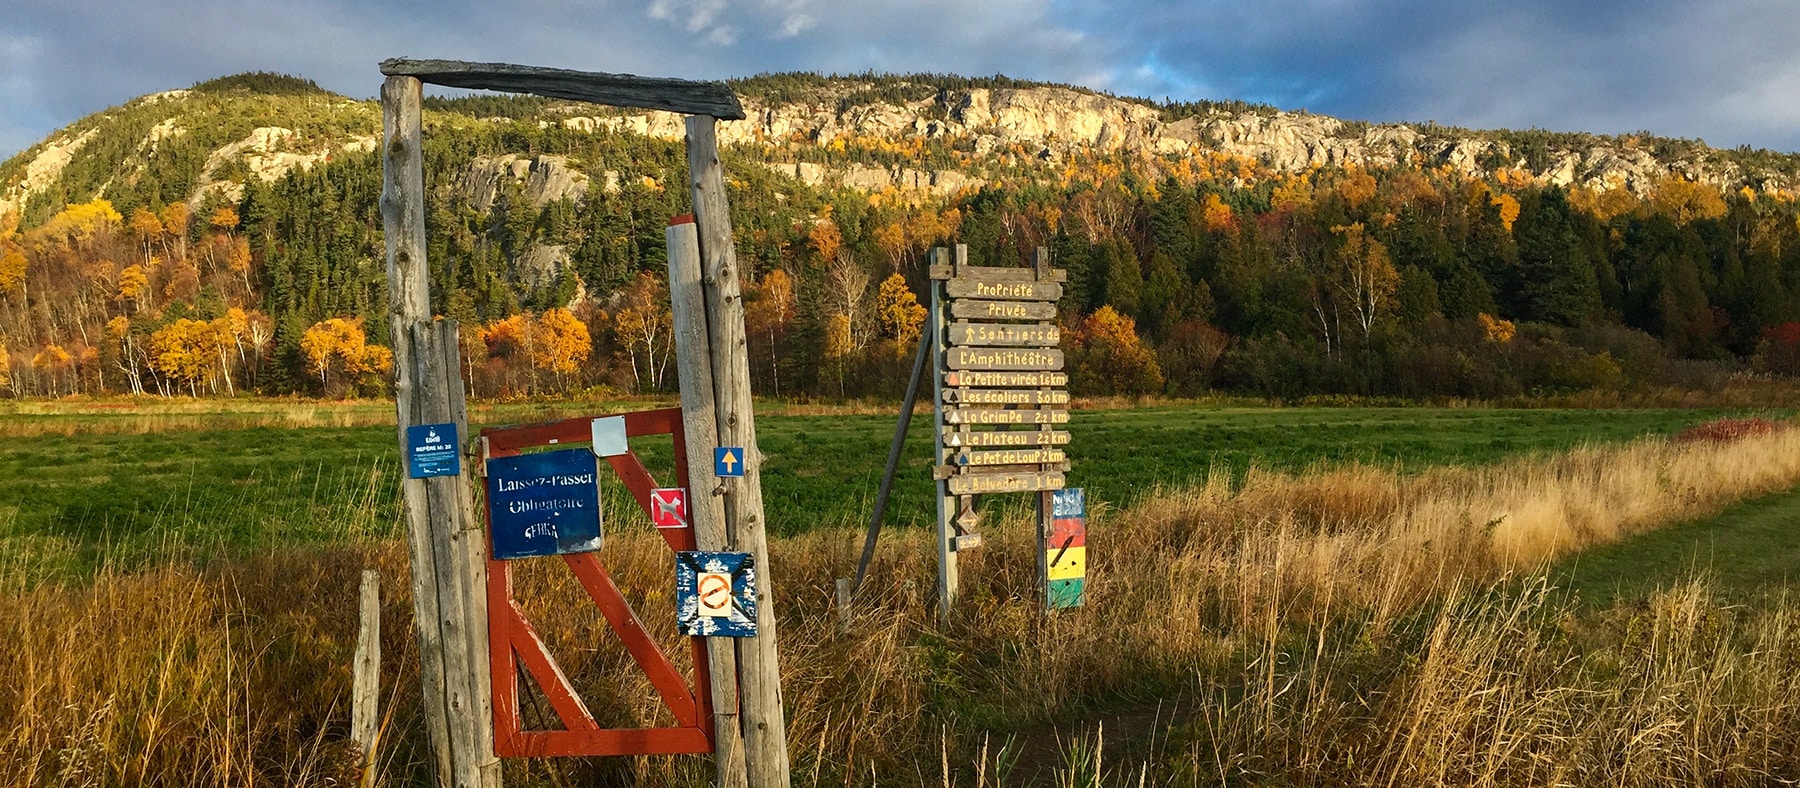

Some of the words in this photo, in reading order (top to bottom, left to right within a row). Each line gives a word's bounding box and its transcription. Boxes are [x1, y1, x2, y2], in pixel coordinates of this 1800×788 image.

[988, 302, 1026, 317] Privée
[979, 327, 1042, 340] Sentiers
[959, 372, 972, 386] La
[975, 372, 1007, 386] Petite
[1010, 373, 1038, 386] virée
[1050, 373, 1066, 386] km
[962, 389, 981, 403] Les
[984, 389, 1030, 404] écoliers
[1051, 391, 1068, 404] km
[963, 409, 977, 423] La
[1051, 411, 1068, 423] km
[965, 433, 979, 446] Le
[982, 432, 1028, 445] Plateau
[1051, 432, 1067, 444] km
[969, 451, 981, 465] Le
[983, 451, 1001, 464] Pet
[1003, 450, 1016, 463] de
[1042, 449, 1049, 462] 2
[1049, 451, 1064, 462] km
[1046, 475, 1062, 487] km
